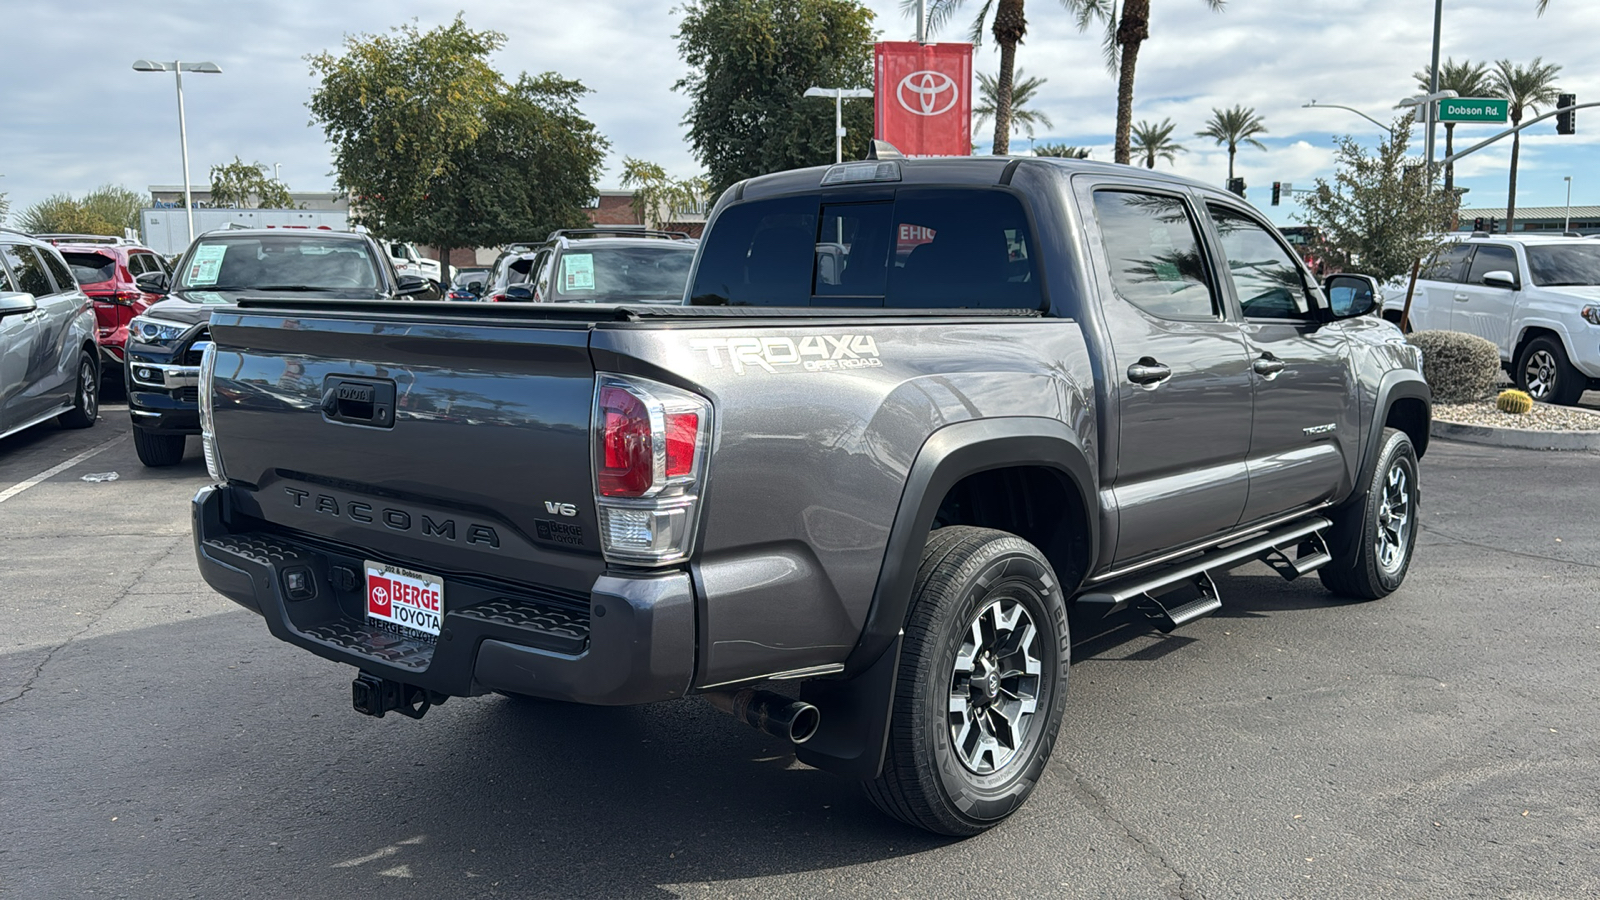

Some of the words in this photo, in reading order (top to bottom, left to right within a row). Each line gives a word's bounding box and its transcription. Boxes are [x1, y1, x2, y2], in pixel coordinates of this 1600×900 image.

[1448, 105, 1482, 115] Dobson
[1485, 106, 1499, 116] Rd.
[689, 336, 801, 376] TRD
[799, 334, 880, 359] 4X4
[803, 358, 838, 372] OFF
[838, 356, 883, 369] ROAD
[340, 386, 369, 400] TOYOTA
[544, 500, 577, 517] V6
[284, 486, 500, 549] TACOMA
[550, 520, 583, 537] BERGE
[552, 533, 584, 546] TOYOTA
[384, 564, 396, 573] 202
[402, 569, 423, 580] Dobson
[392, 580, 440, 612] BERGE
[368, 616, 404, 634] BERGE
[392, 605, 441, 631] TOYOTA
[1054, 604, 1069, 653] ECO
